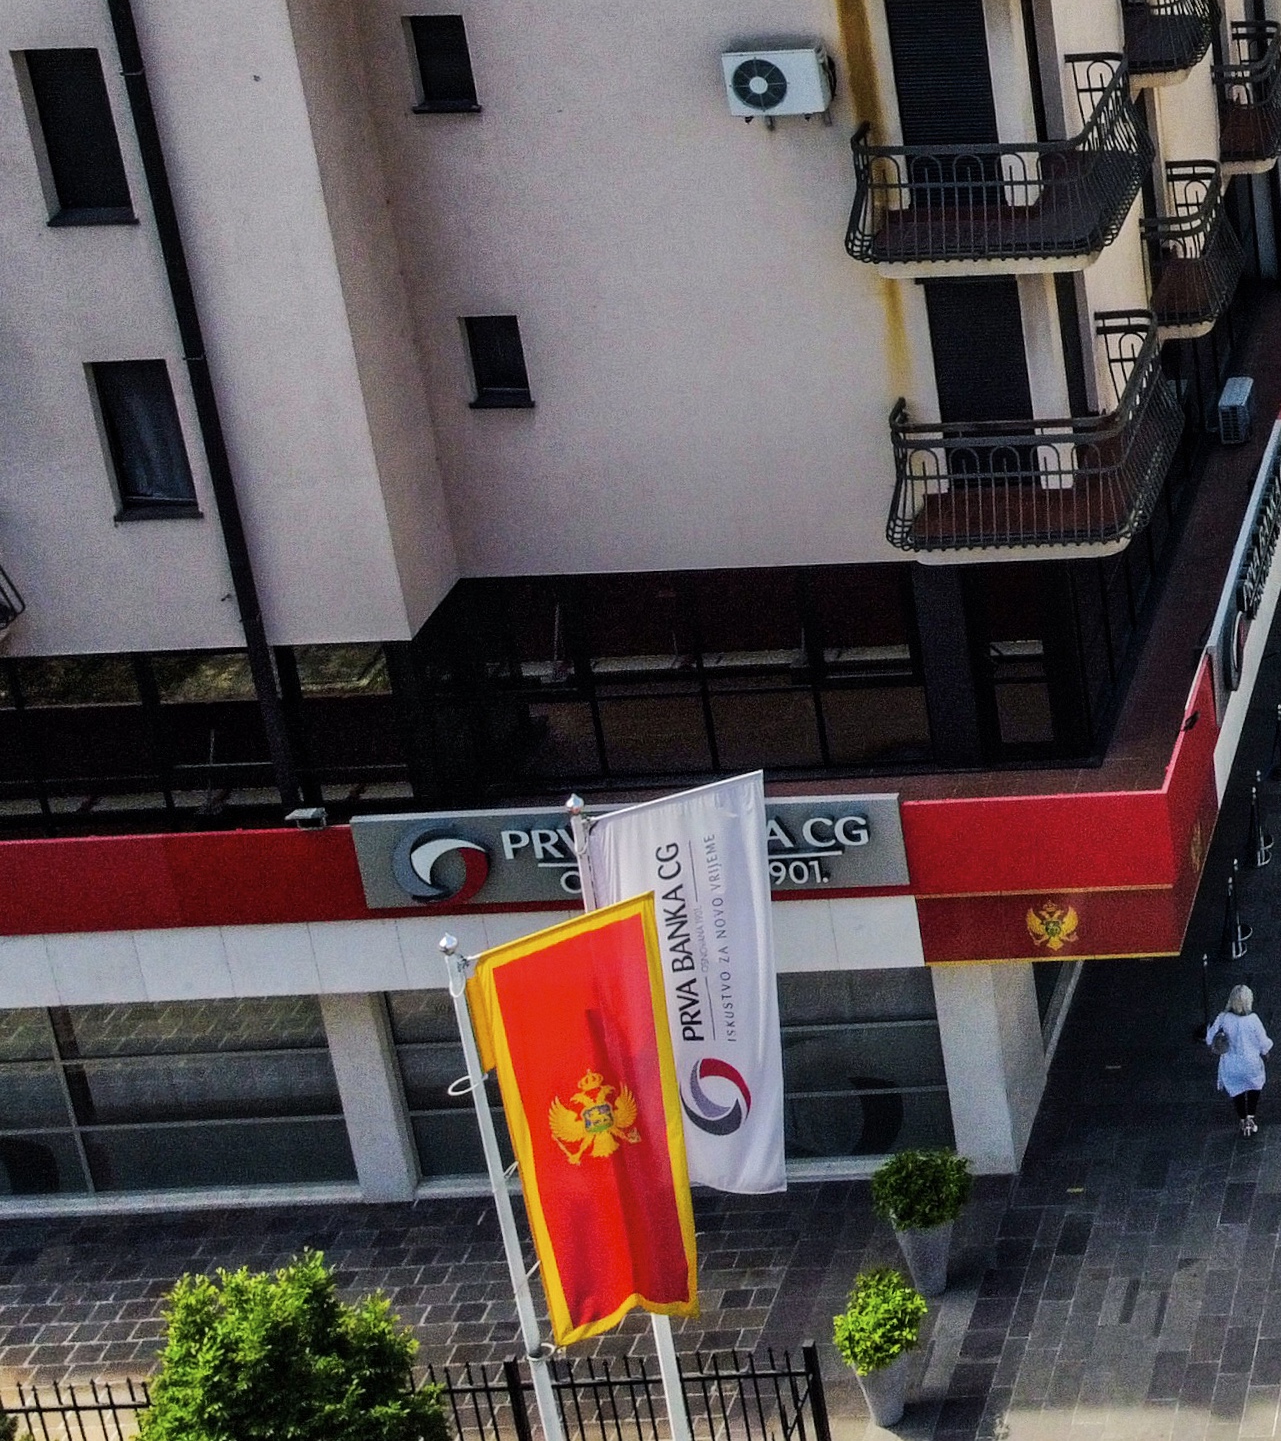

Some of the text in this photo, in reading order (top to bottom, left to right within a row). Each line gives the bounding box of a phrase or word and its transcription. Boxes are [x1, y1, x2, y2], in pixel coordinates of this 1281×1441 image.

[768, 860, 829, 885] 901.
[802, 816, 869, 849] CG
[655, 841, 705, 1042] PRVA BANKA CG
[704, 834, 737, 1043] ISKUSTVO ZA NOVO VRIJEME
